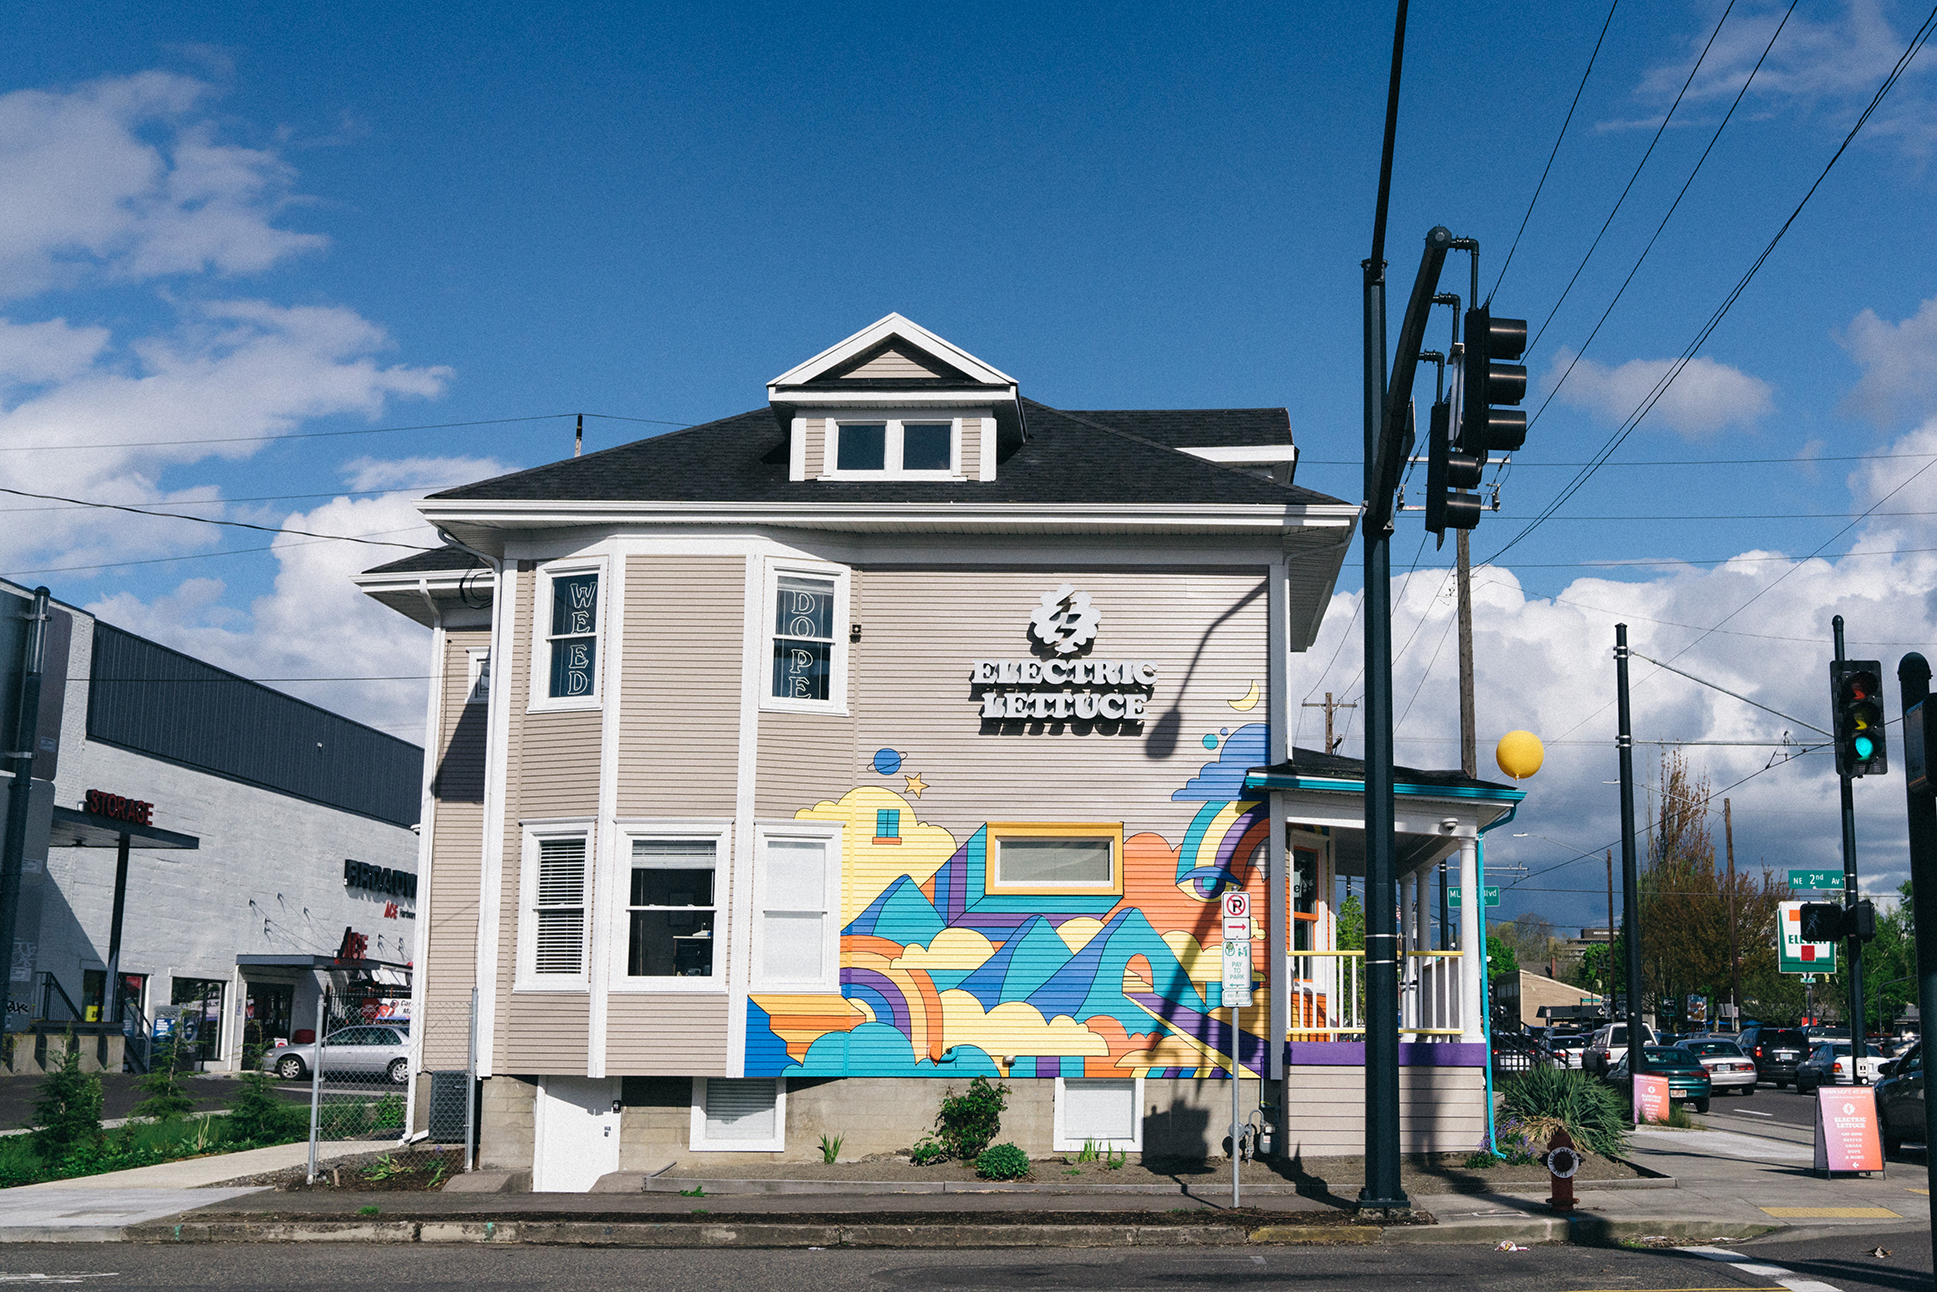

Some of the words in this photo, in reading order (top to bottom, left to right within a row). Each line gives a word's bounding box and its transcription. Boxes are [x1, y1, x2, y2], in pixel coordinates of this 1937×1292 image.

[568, 582, 597, 695] WEED
[789, 591, 815, 700] DOPE
[971, 658, 1159, 685] ELECTRIC
[981, 692, 1149, 720] LETTUCE
[89, 789, 154, 826] STORAGE
[1793, 877, 1803, 885] NE
[1809, 874, 1824, 885] 2nd
[1831, 877, 1840, 885] Av
[384, 900, 398, 919] ACE
[341, 927, 369, 960] ACE
